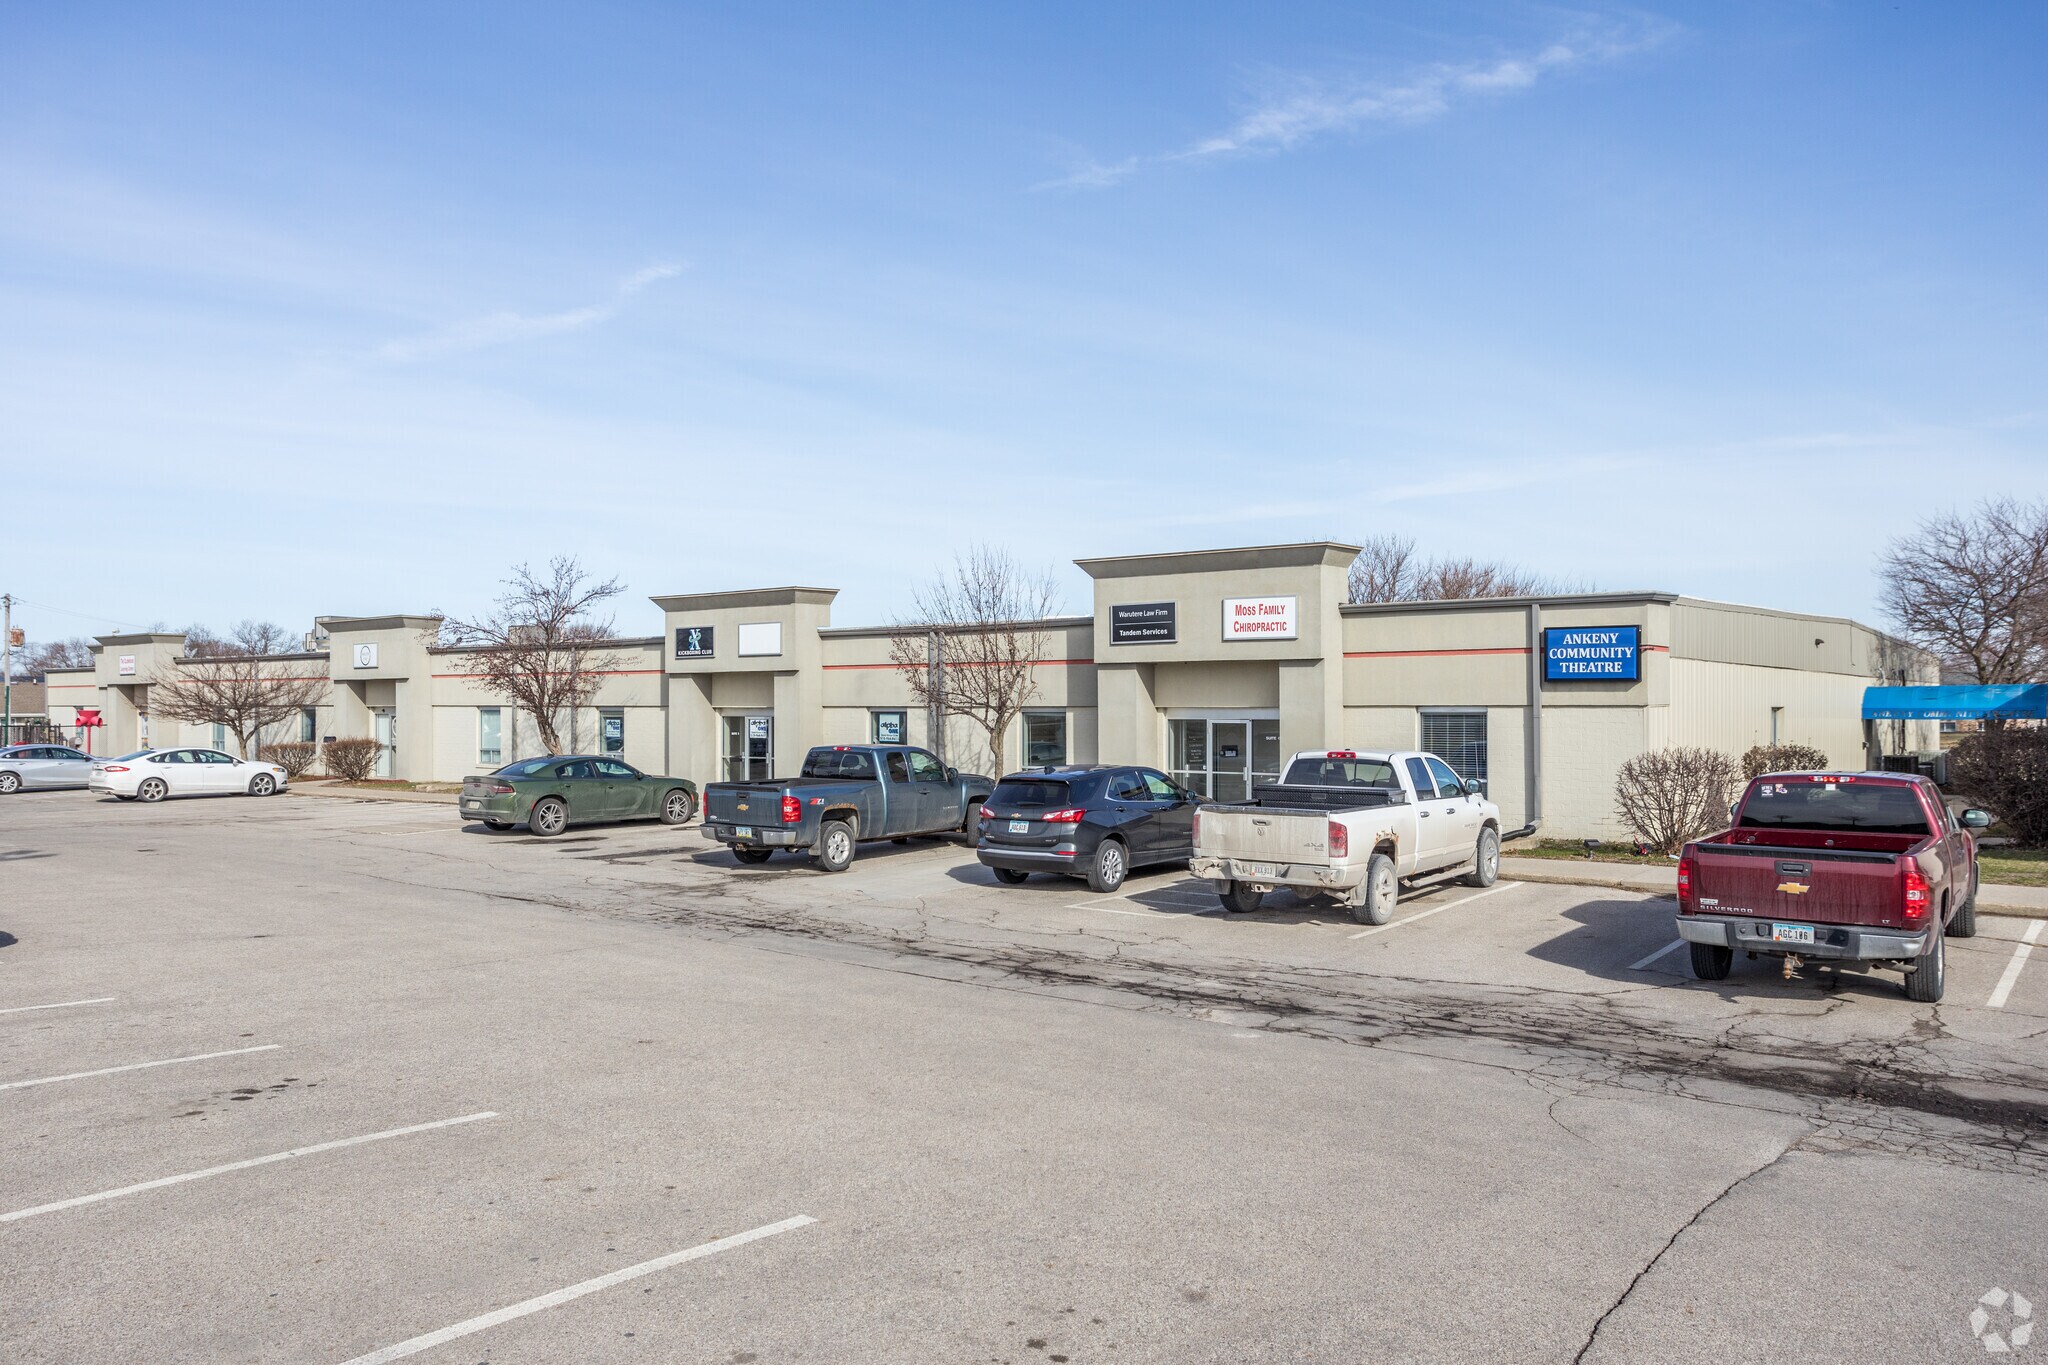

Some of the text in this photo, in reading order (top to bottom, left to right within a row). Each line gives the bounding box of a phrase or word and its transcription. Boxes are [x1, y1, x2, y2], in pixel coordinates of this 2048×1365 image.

[1562, 632, 1620, 644] ANKENY
[1549, 647, 1634, 659] COMMUNITY
[1560, 662, 1623, 672] THEATRE
[880, 722, 898, 730] alpha
[1700, 904, 1753, 914] SILVERADO
[1778, 929, 1792, 939] AGC
